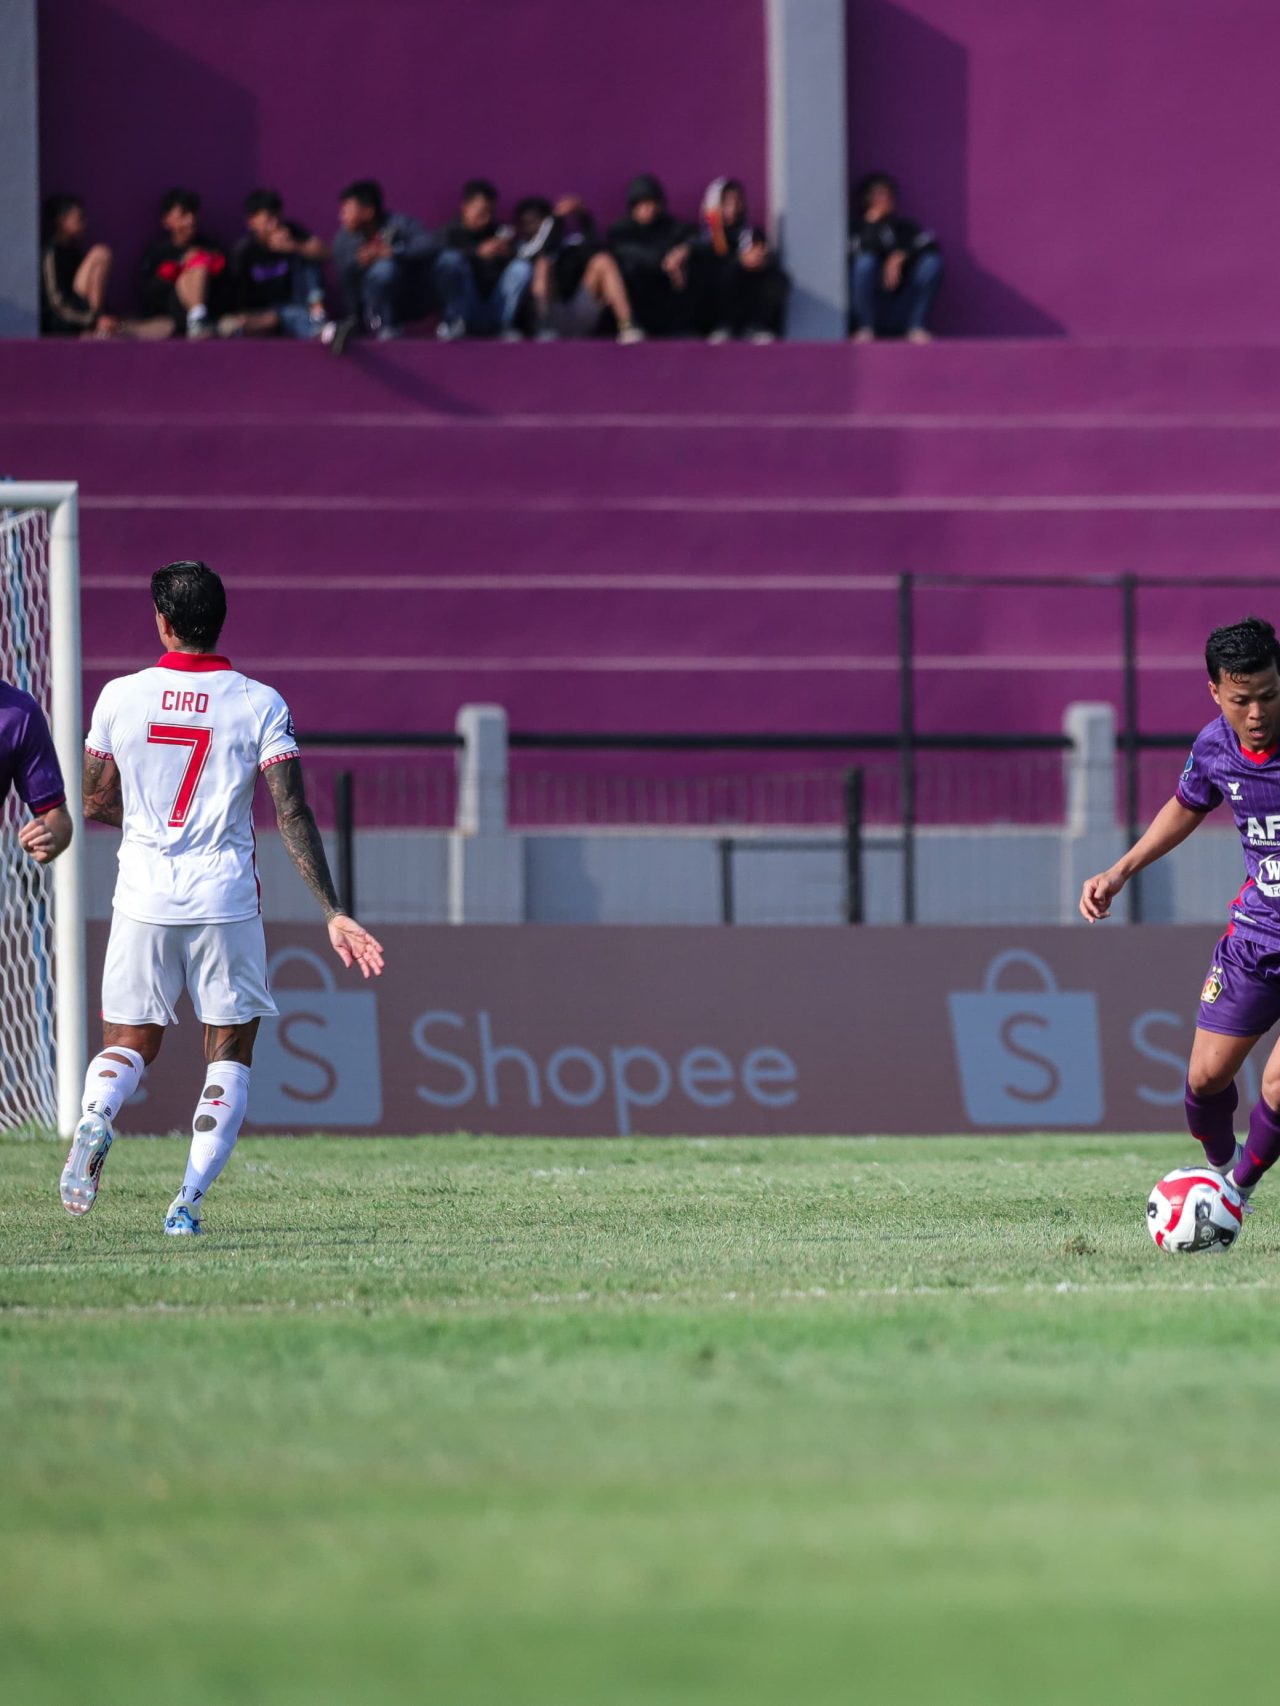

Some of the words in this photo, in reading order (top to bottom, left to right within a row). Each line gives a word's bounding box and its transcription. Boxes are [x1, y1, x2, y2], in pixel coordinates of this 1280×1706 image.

[161, 690, 209, 713] CIRO
[146, 721, 214, 828] 7
[412, 1010, 798, 1137] Shopee
